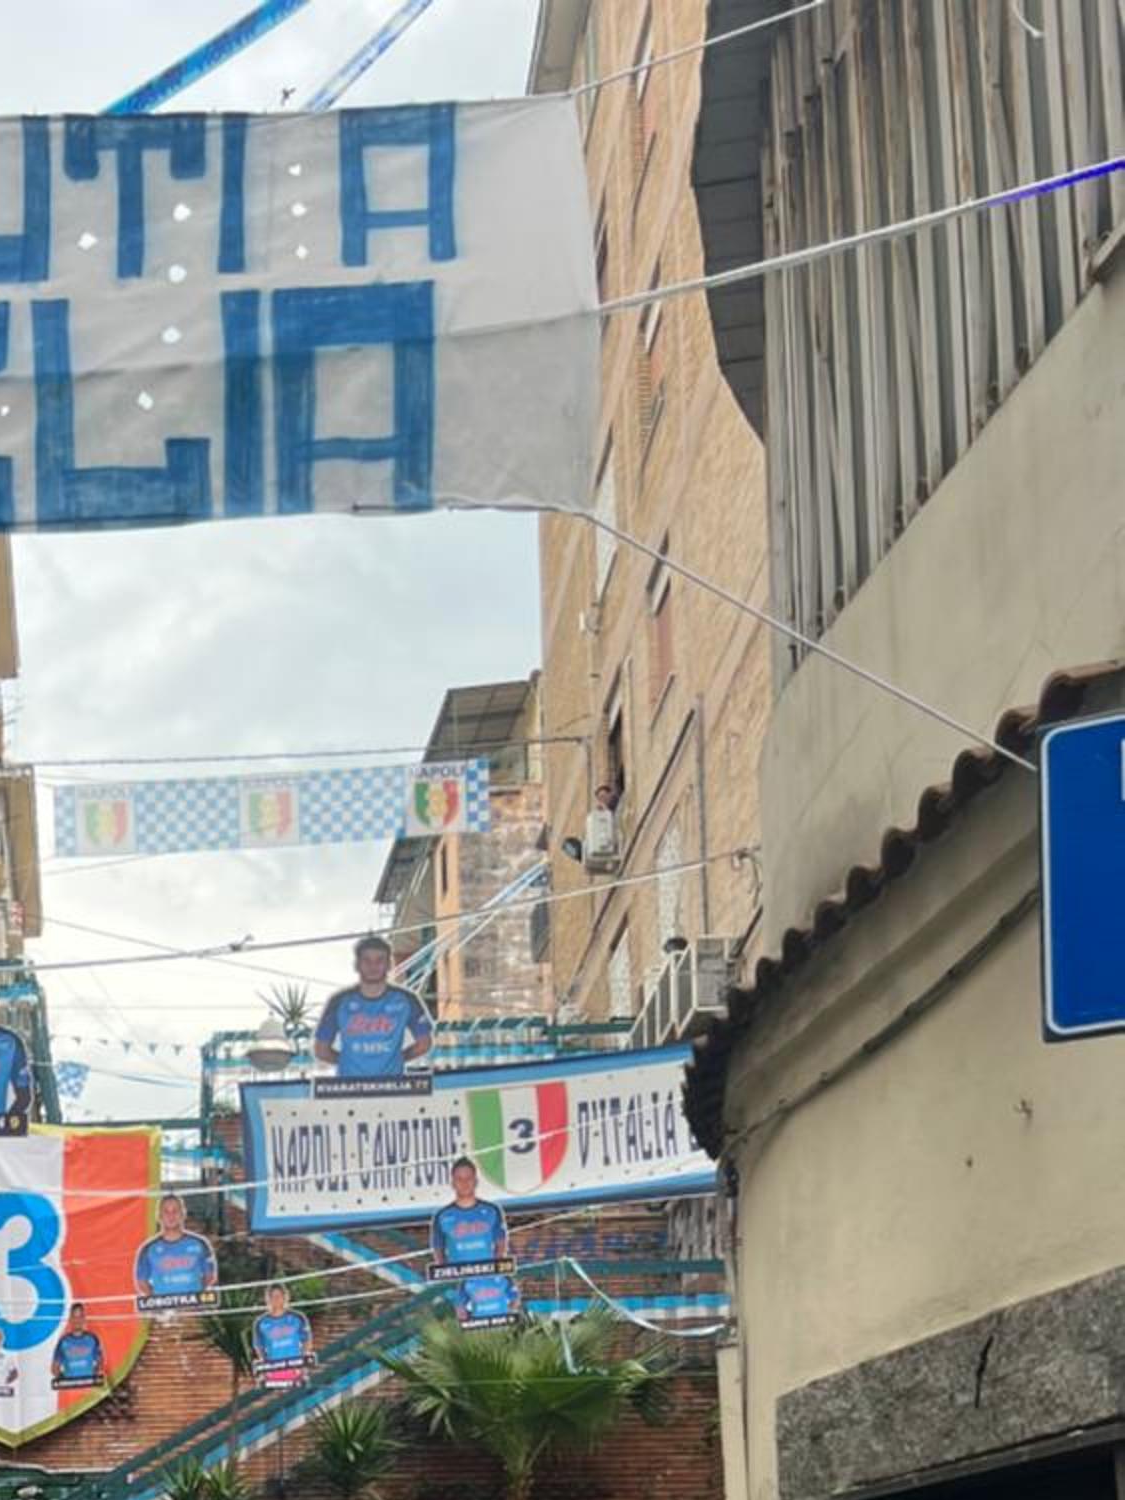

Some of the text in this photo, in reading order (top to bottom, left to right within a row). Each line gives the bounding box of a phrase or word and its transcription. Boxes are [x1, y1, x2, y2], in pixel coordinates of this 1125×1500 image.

[339, 102, 458, 266] A
[271, 1122, 349, 1194] NAPOLI
[507, 1118, 537, 1155] 3
[577, 1091, 679, 1170] D'ITALIA
